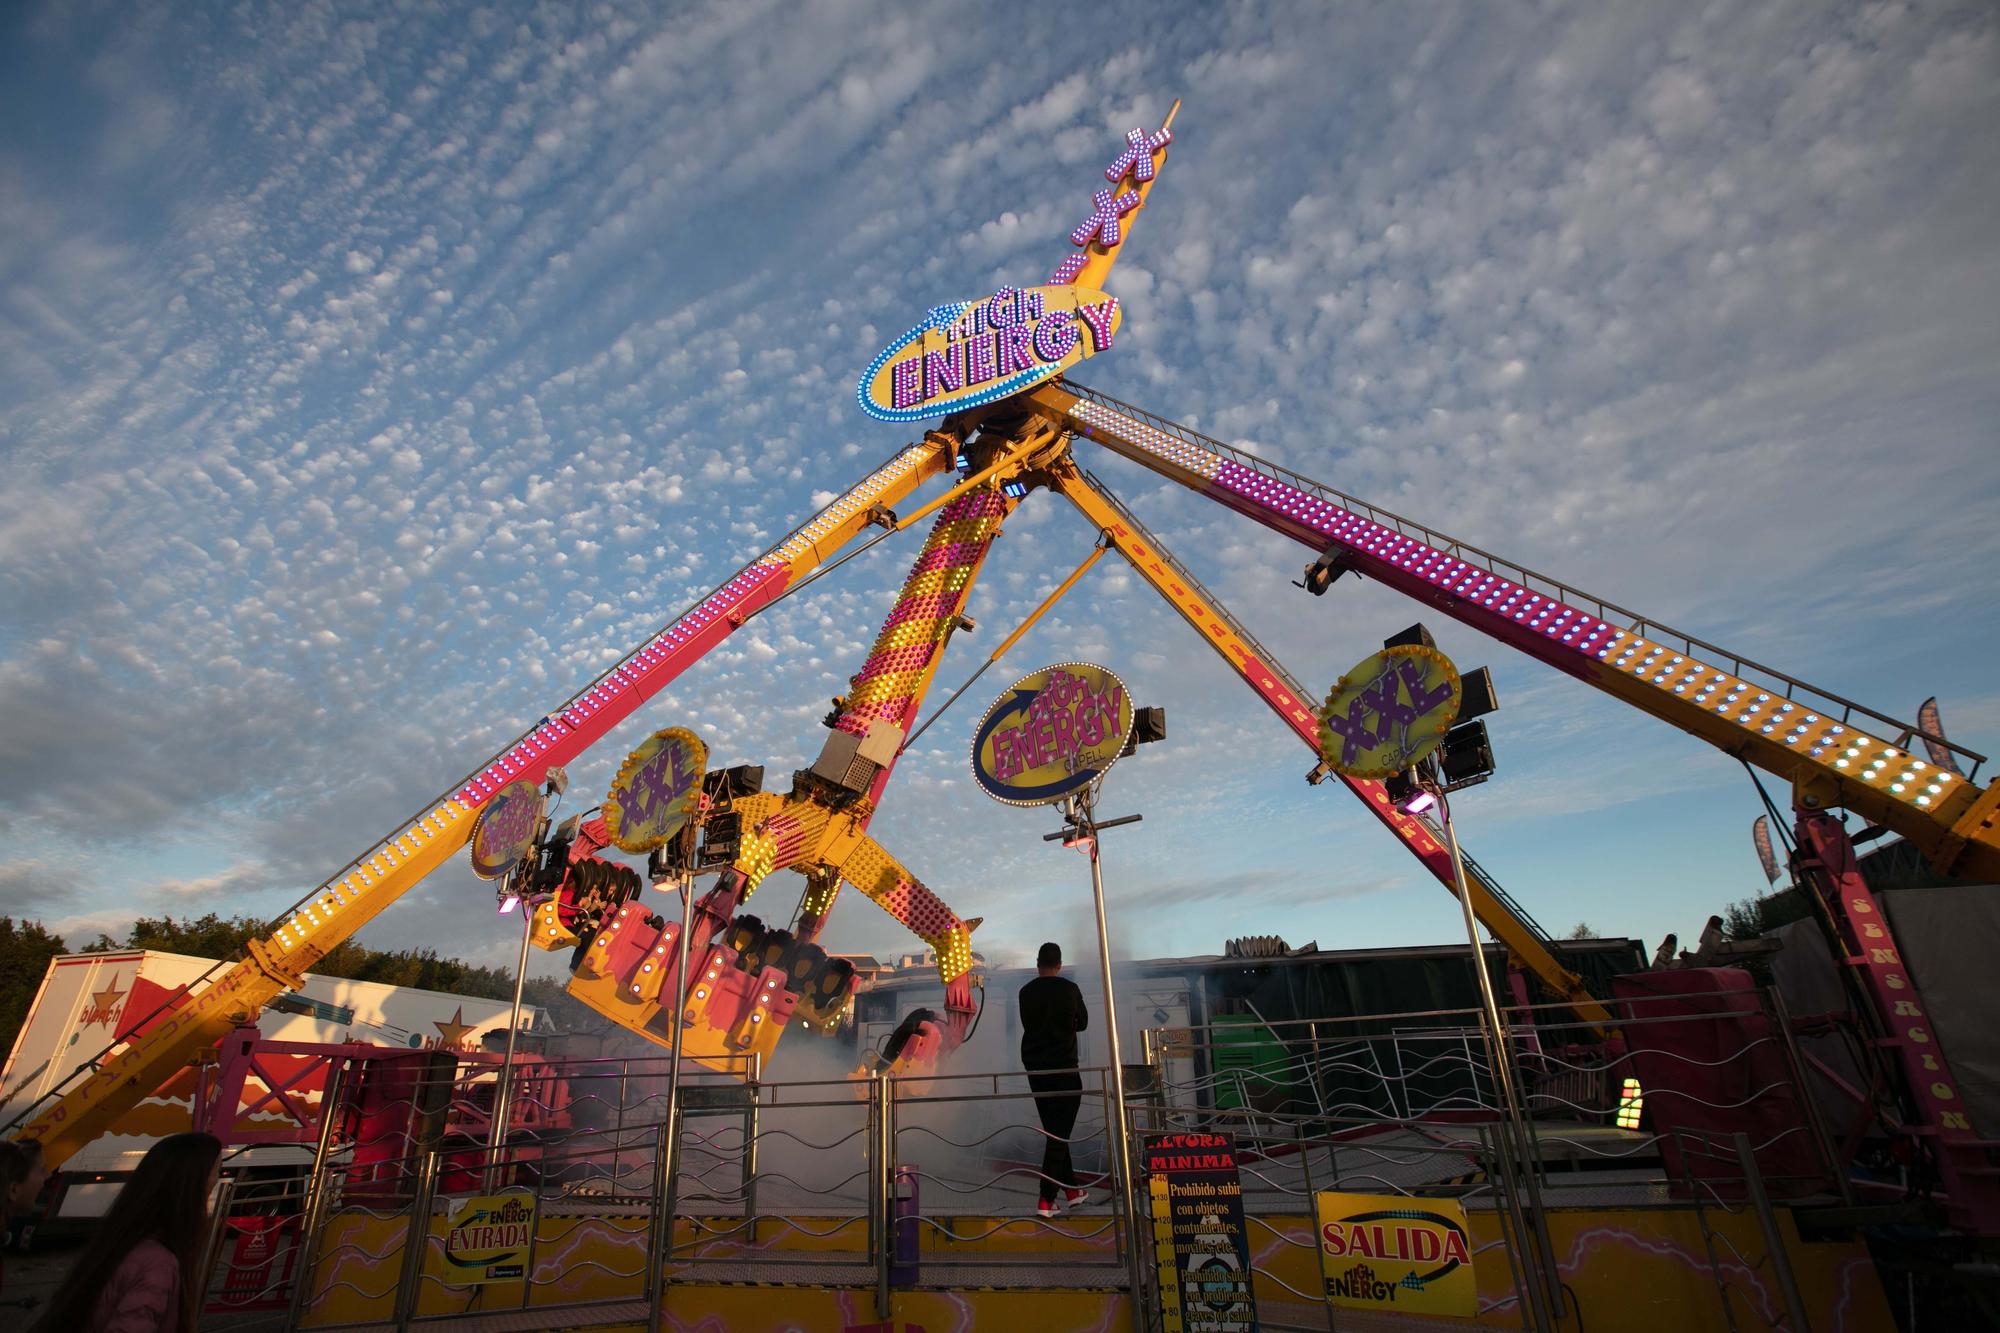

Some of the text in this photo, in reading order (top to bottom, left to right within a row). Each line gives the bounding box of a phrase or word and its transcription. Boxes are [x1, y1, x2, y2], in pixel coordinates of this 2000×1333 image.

[947, 285, 1044, 342] HIGH
[892, 298, 1119, 409] ENERGY
[1029, 671, 1089, 721] HIGH
[1327, 657, 1453, 768] XXL
[992, 685, 1122, 782] ENERGY
[617, 740, 696, 839] XXL
[1852, 898, 1970, 1130] SENSACION
[1150, 1154, 1235, 1170] MINIMA
[1170, 1181, 1241, 1197] Prohibido subir
[489, 1208, 534, 1224] ENERGY
[1176, 1201, 1230, 1218] con objetos
[448, 1224, 529, 1252] ENTRADA
[1160, 1237, 1173, 1245] 110
[1321, 1221, 1472, 1266] SALIDA
[1162, 1259, 1176, 1268] 100
[1344, 1263, 1375, 1282] HIGH
[1181, 1267, 1224, 1283] Prohibido
[1166, 1284, 1176, 1292] 90
[1325, 1277, 1398, 1301] ENERGY
[1168, 1307, 1178, 1316] 80
[1185, 1310, 1215, 1324] graves
[1215, 1309, 1228, 1322] de
